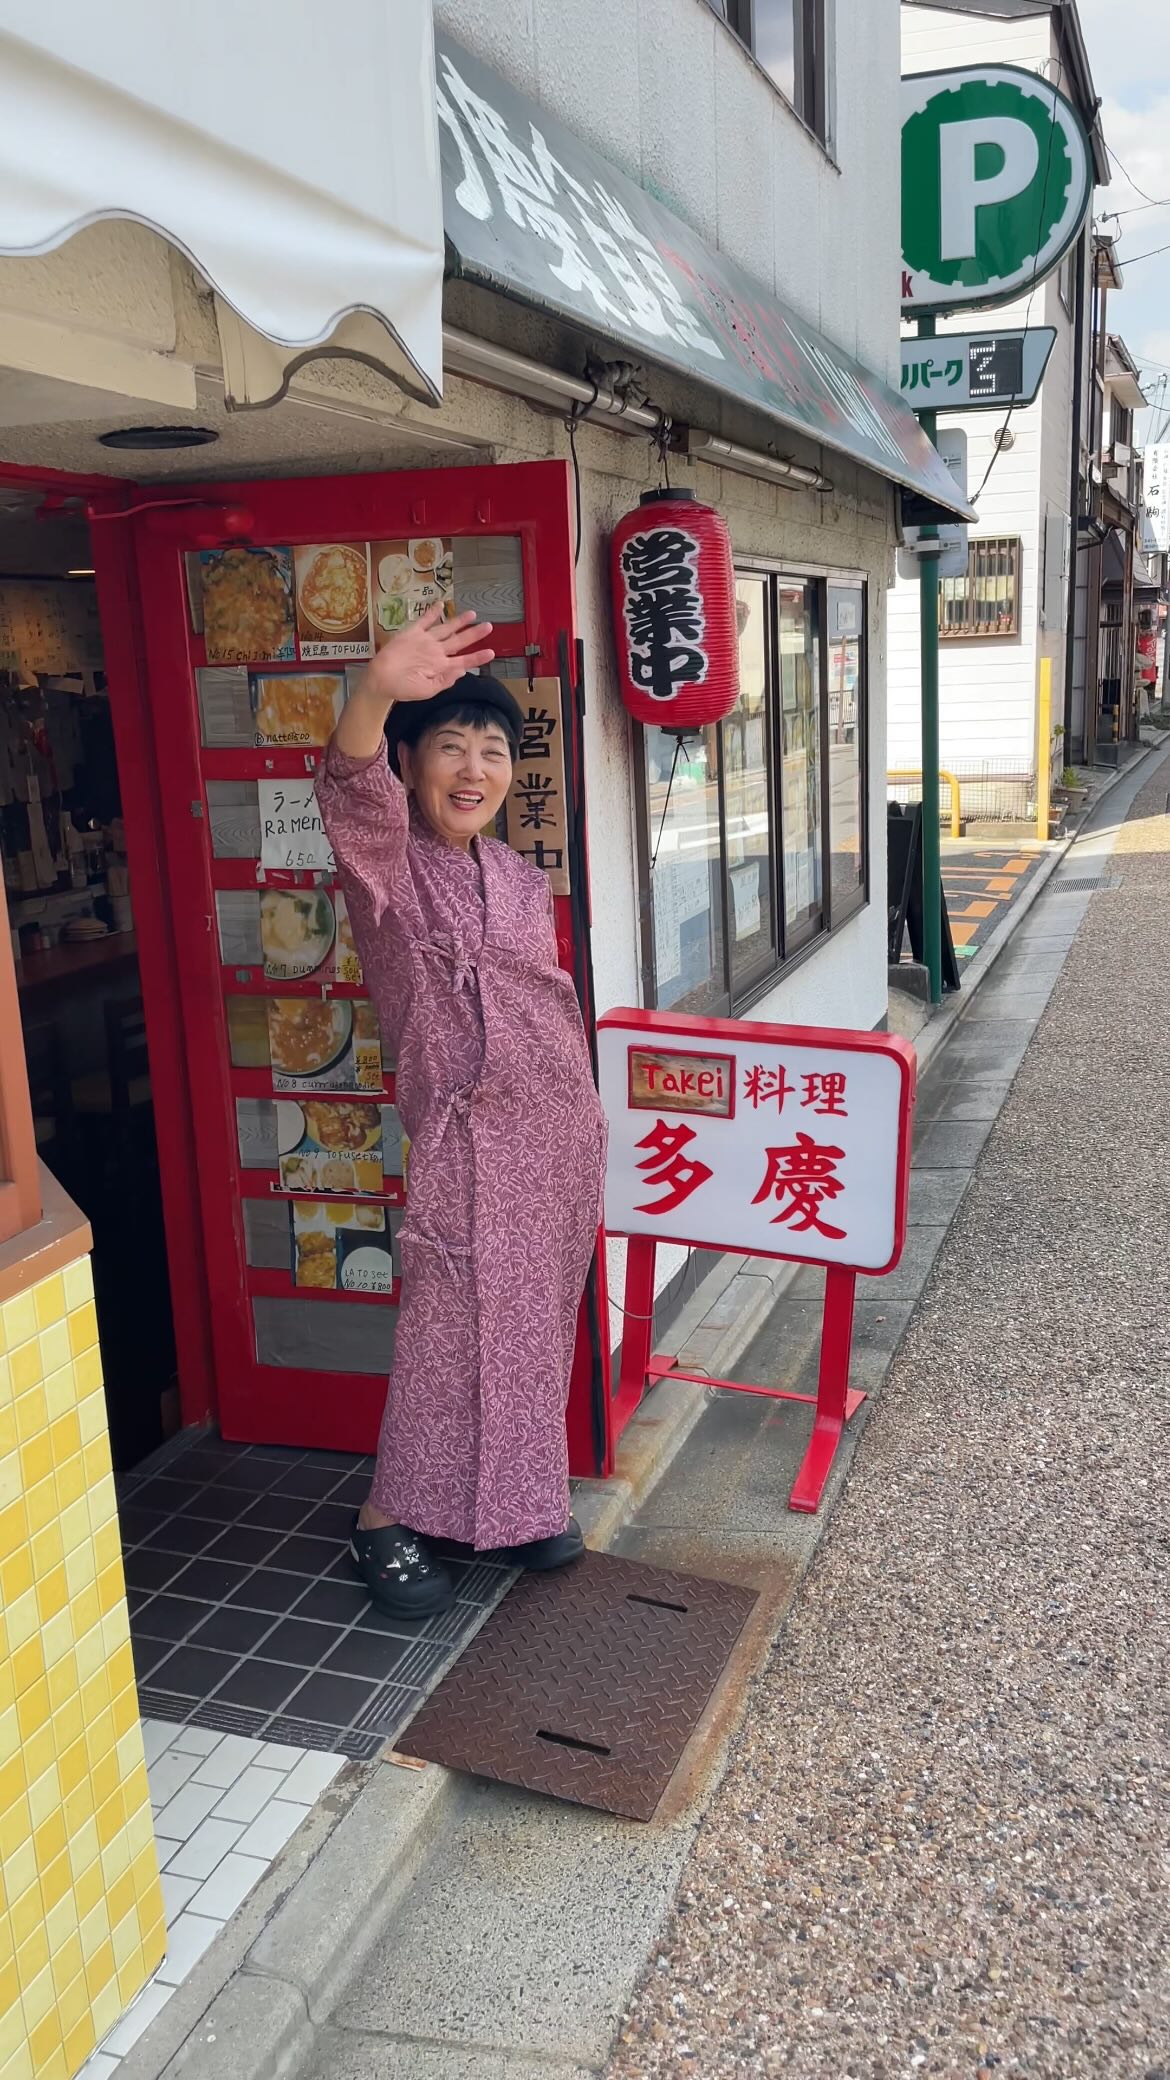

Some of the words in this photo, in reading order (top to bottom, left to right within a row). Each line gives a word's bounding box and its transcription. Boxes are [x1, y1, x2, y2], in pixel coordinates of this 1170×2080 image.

[940, 116, 1040, 262] P
[621, 530, 705, 697] 営業中
[274, 792, 314, 812] ラーメ
[640, 1064, 723, 1098] Takei
[743, 1063, 849, 1118] 料理
[632, 1118, 848, 1240] 多慶
